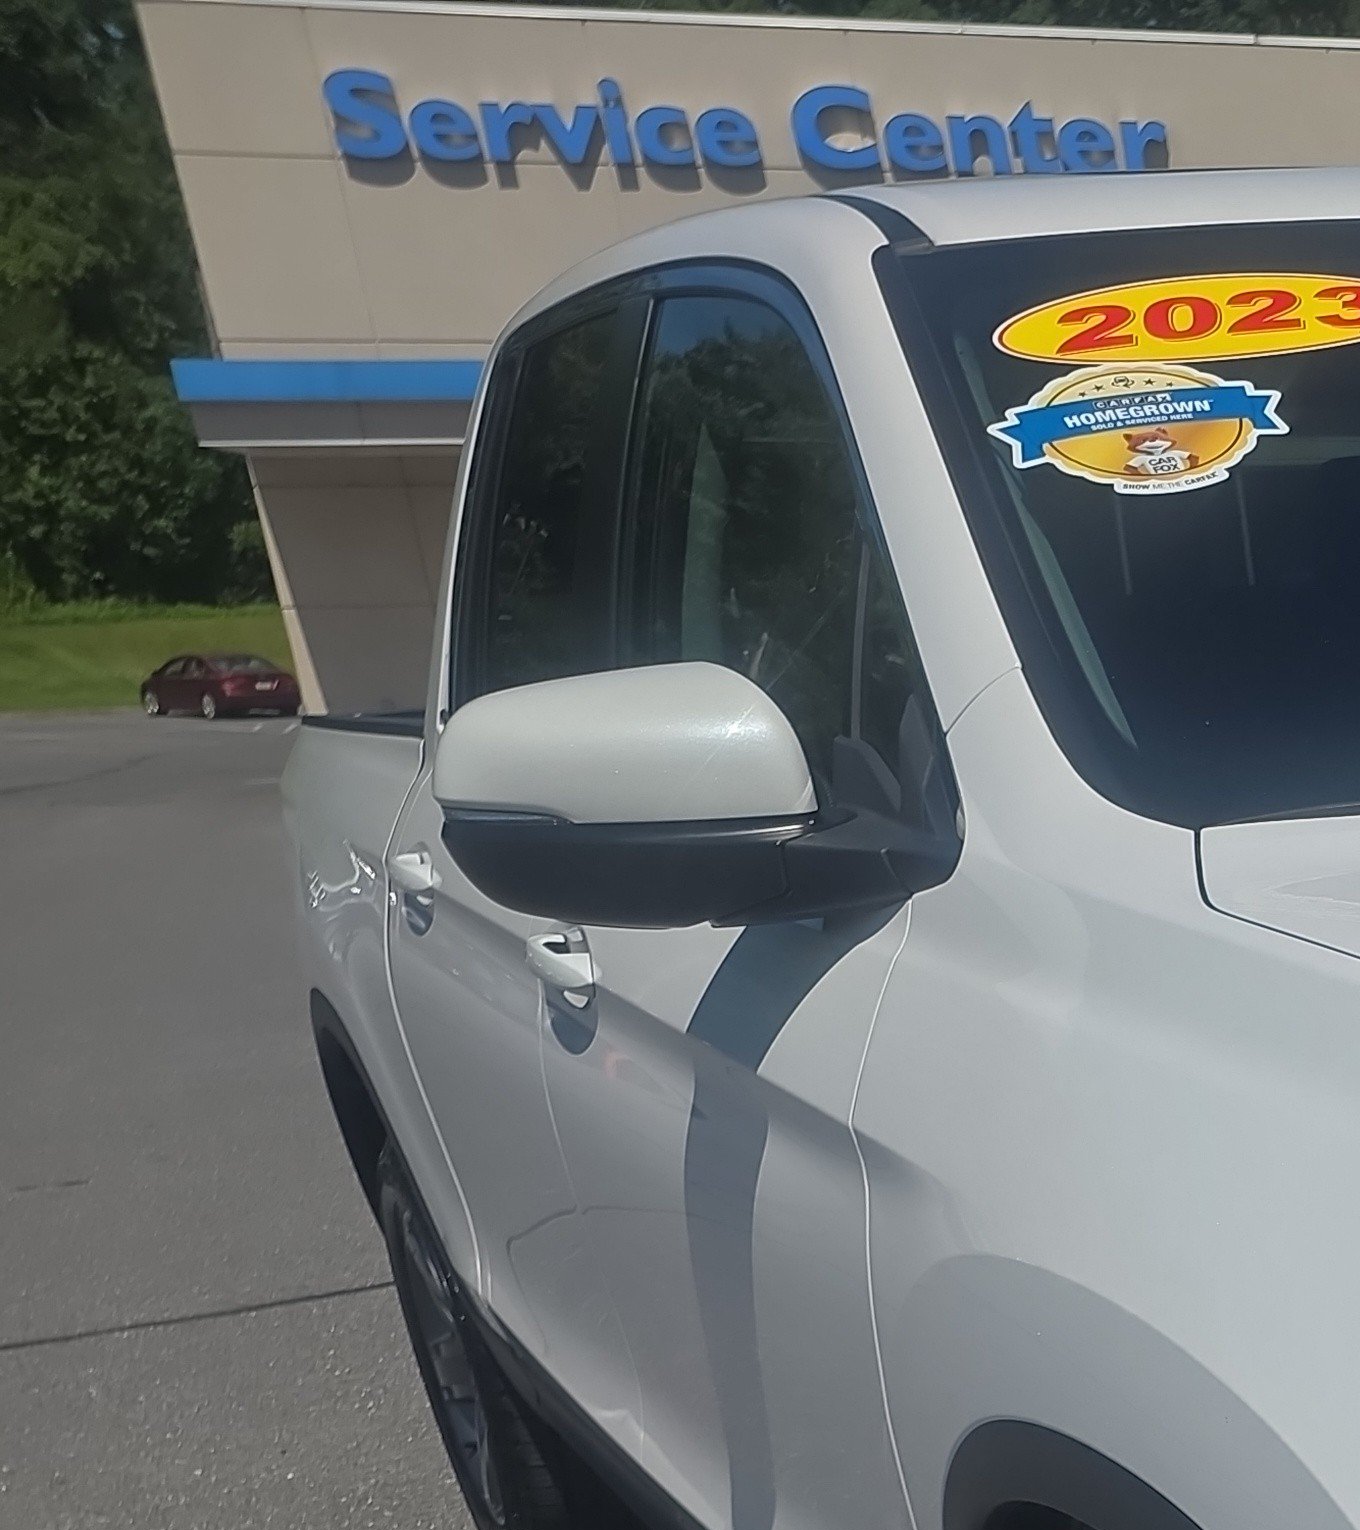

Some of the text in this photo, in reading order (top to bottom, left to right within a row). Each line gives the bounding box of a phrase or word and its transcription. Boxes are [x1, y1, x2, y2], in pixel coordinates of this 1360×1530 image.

[322, 68, 1167, 176] Service Center
[1094, 393, 1172, 410] CARFAX
[1063, 399, 1212, 428] HOMEGROWN
[1090, 422, 1115, 431] SOLD
[1125, 415, 1168, 425] SERVICED
[1170, 413, 1194, 421] HERE
[1148, 456, 1178, 466] CAR
[1153, 463, 1181, 474] FOX
[1184, 470, 1219, 486] CARFAX
